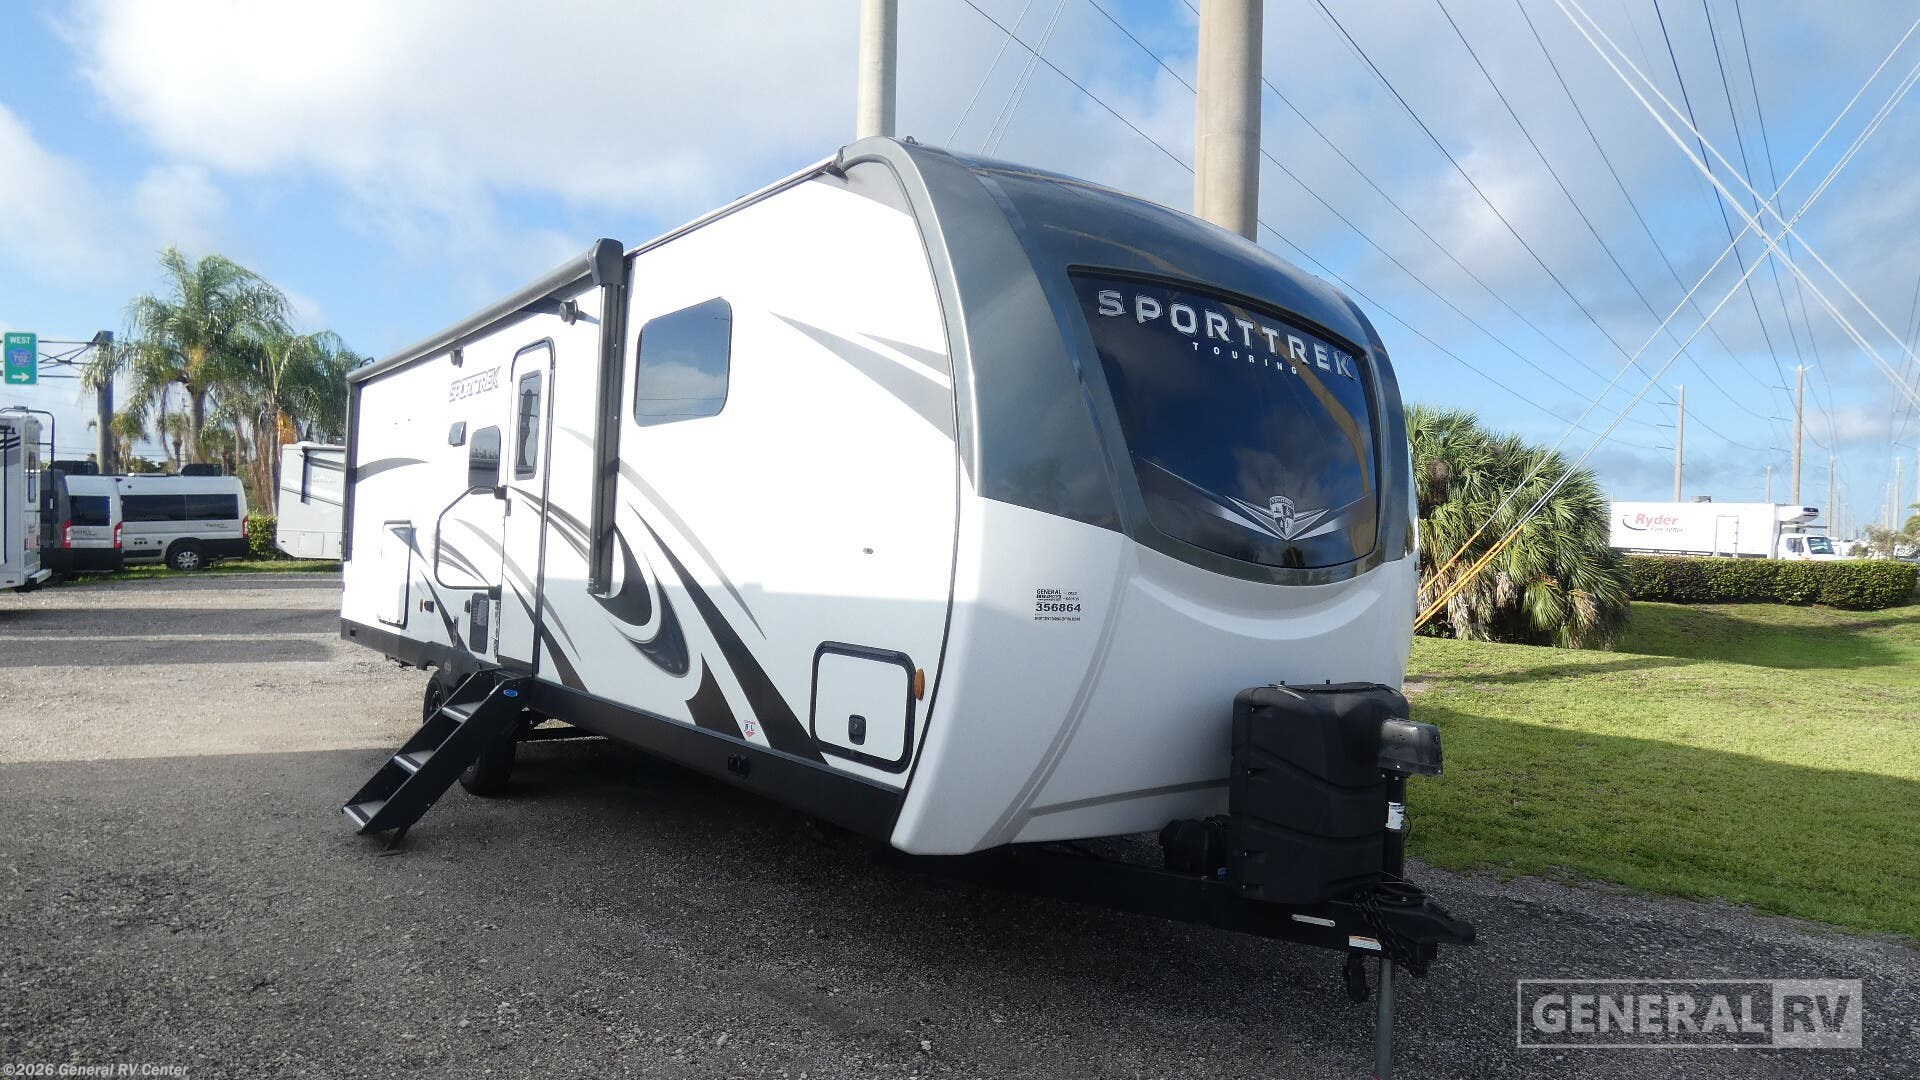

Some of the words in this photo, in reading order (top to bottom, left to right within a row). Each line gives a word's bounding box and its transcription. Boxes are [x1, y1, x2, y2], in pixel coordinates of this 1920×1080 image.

[10, 336, 30, 344] WEST
[1097, 289, 1359, 381] SPORTTREK
[1192, 341, 1298, 375] TOURING
[1635, 513, 1679, 527] Ryder
[1035, 603, 1081, 612] 356864
